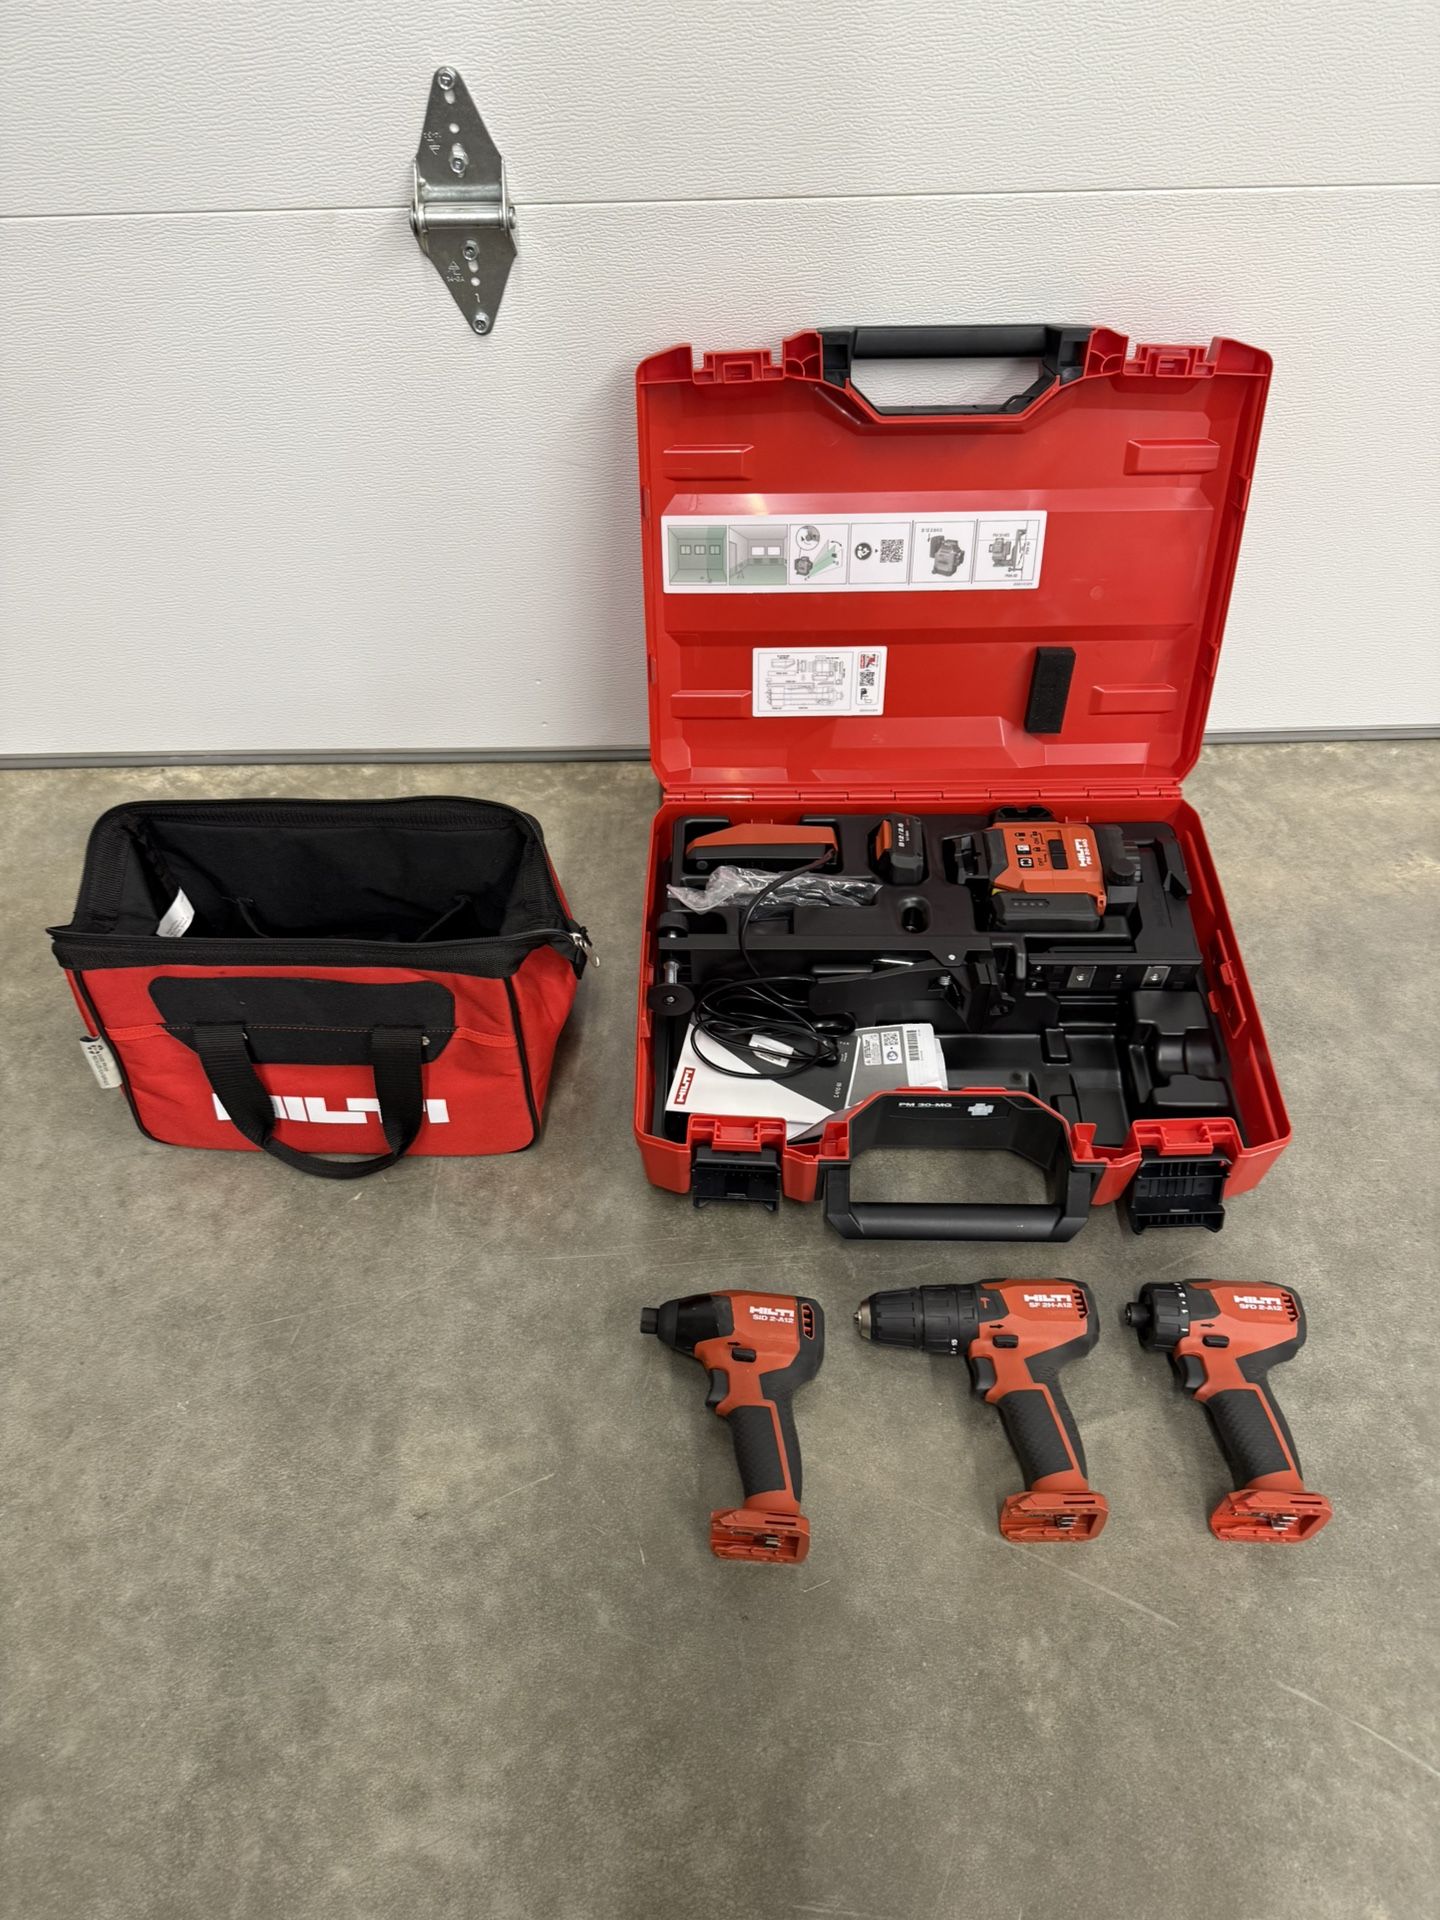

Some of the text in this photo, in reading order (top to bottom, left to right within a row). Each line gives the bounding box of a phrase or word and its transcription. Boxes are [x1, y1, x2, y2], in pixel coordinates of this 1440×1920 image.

[1075, 839, 1088, 868] HILTI
[676, 1069, 694, 1103] HILTI
[1023, 1294, 1072, 1303] HILTI
[1233, 1295, 1281, 1305] HILTI
[749, 1306, 795, 1317] HILTI
[1238, 1303, 1283, 1312] SFD 2-A12
[769, 1316, 794, 1324] 2-A12
